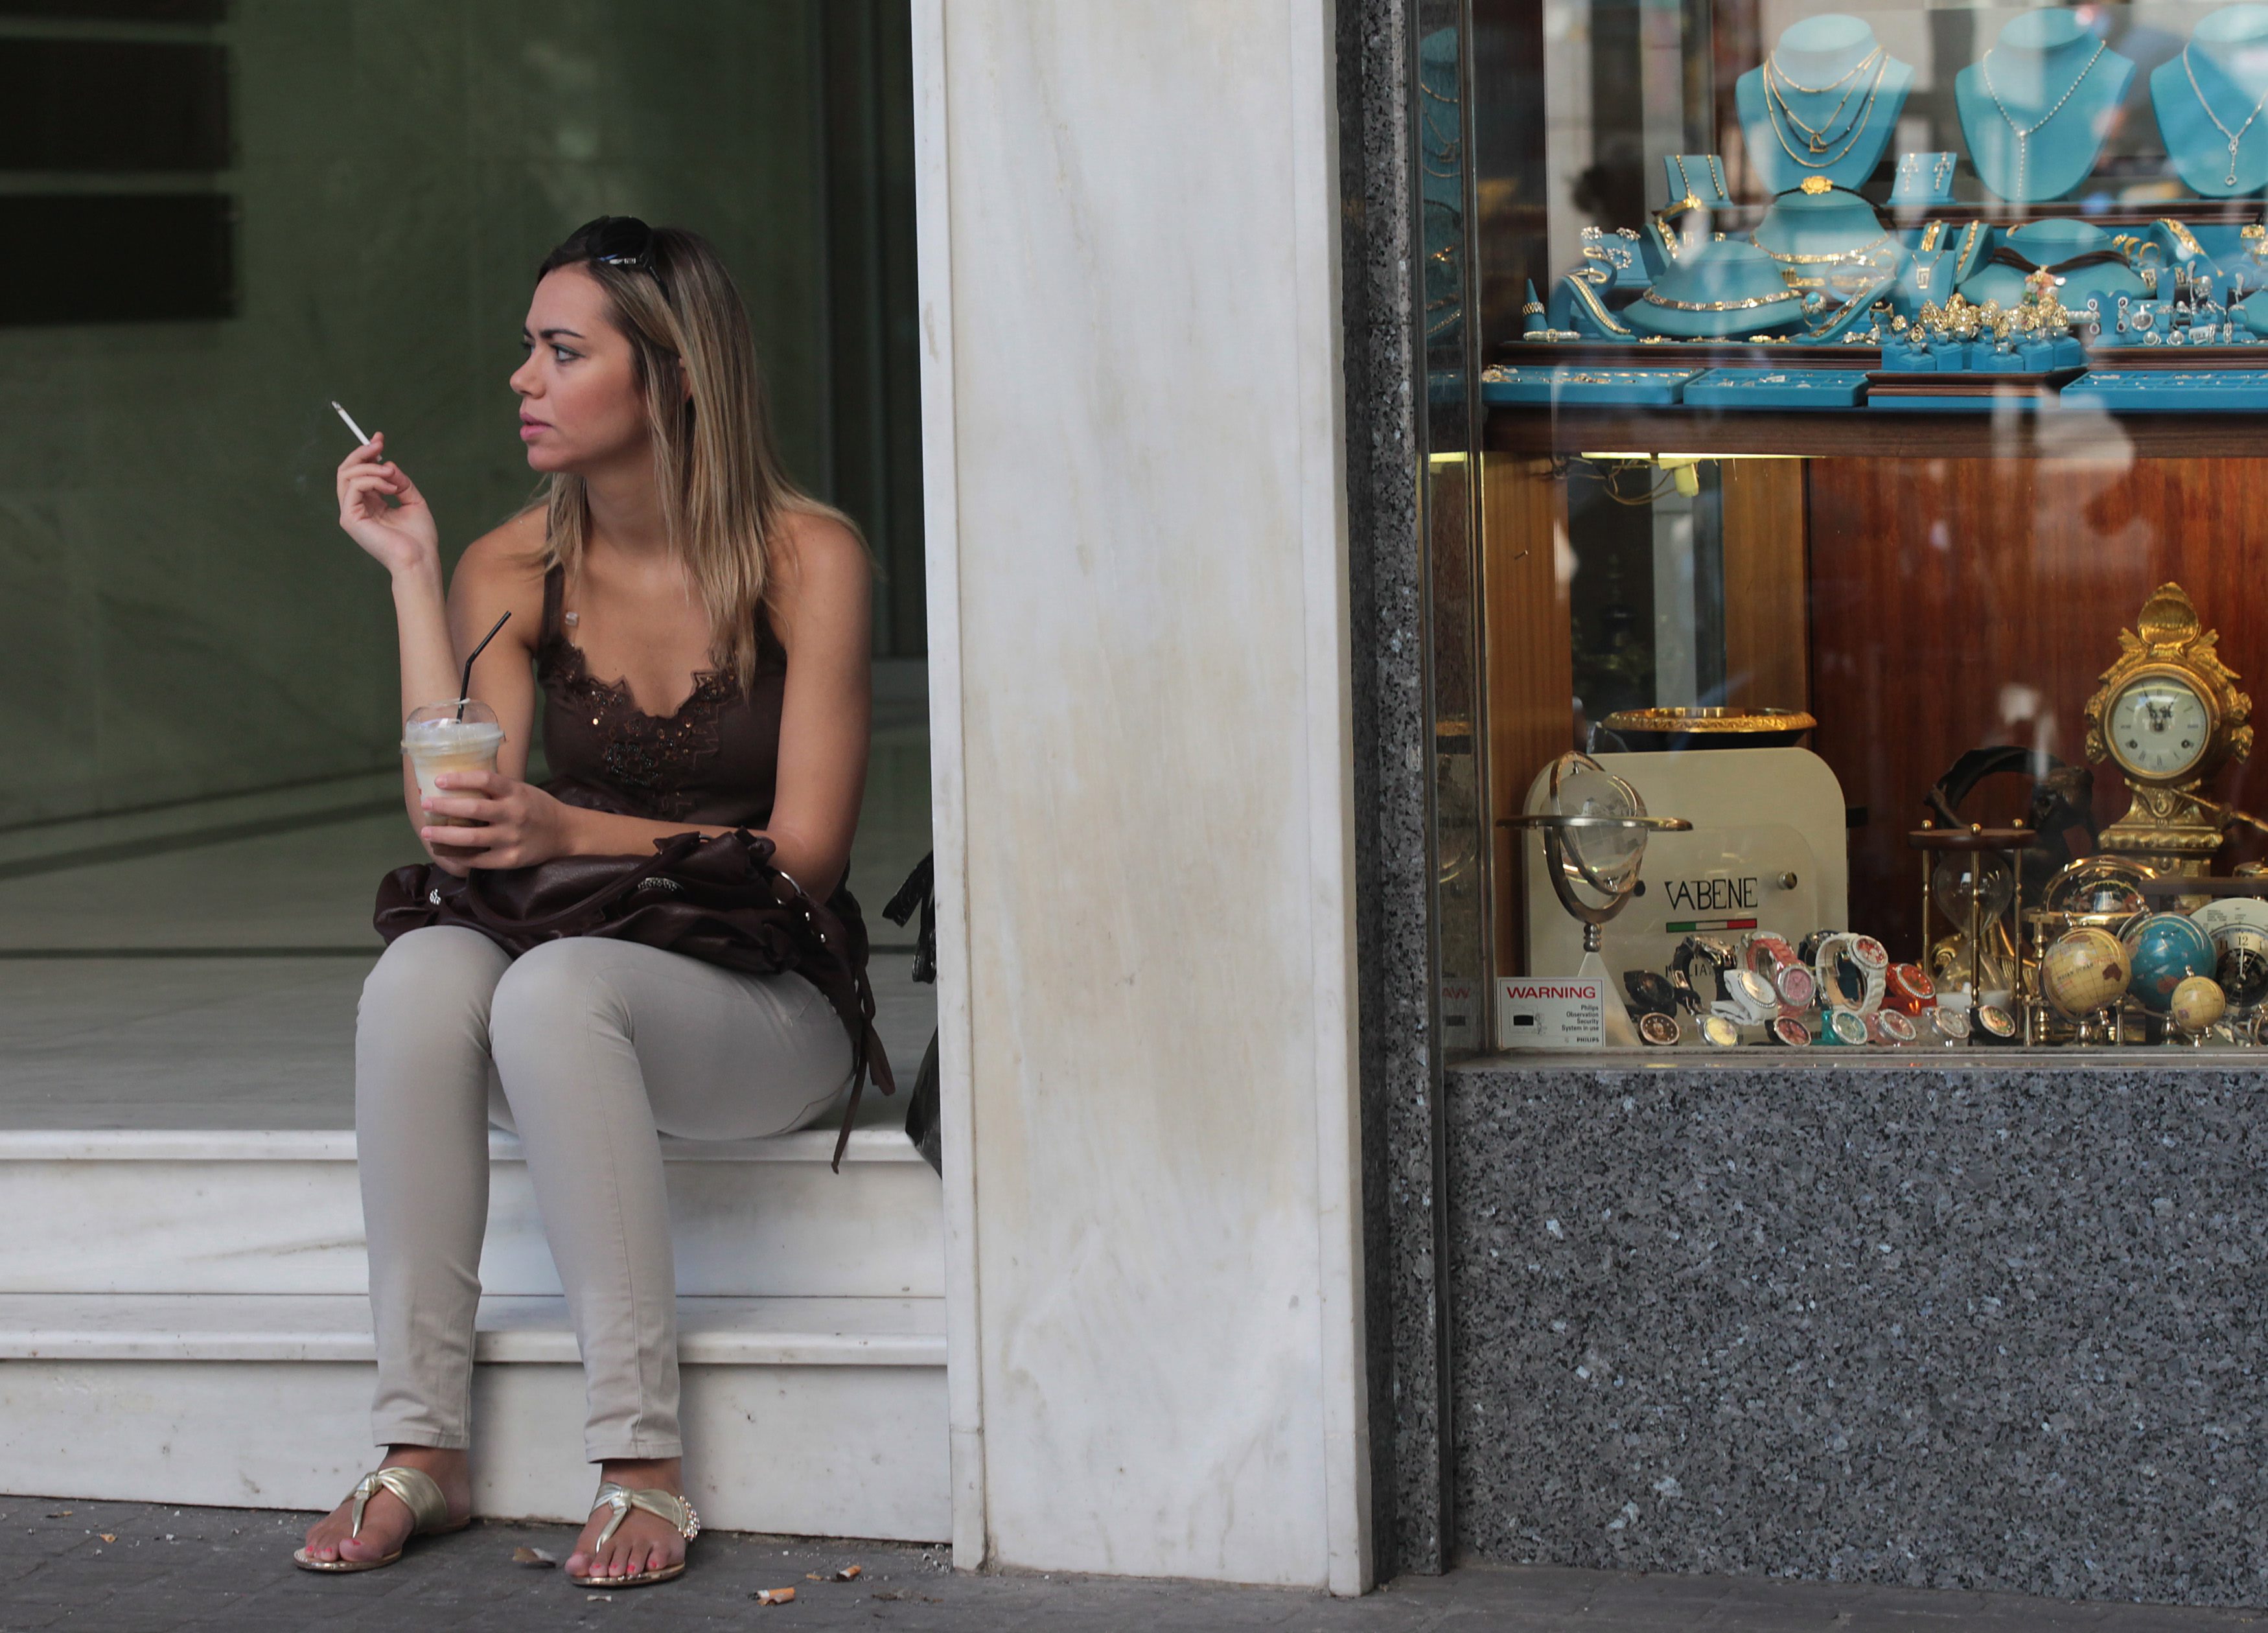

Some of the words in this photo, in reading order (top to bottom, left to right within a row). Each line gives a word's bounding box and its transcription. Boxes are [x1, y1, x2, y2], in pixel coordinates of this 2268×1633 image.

[1664, 877, 1758, 910] VABENE
[2238, 935, 2249, 946] 12
[1507, 986, 1596, 999] WARNING
